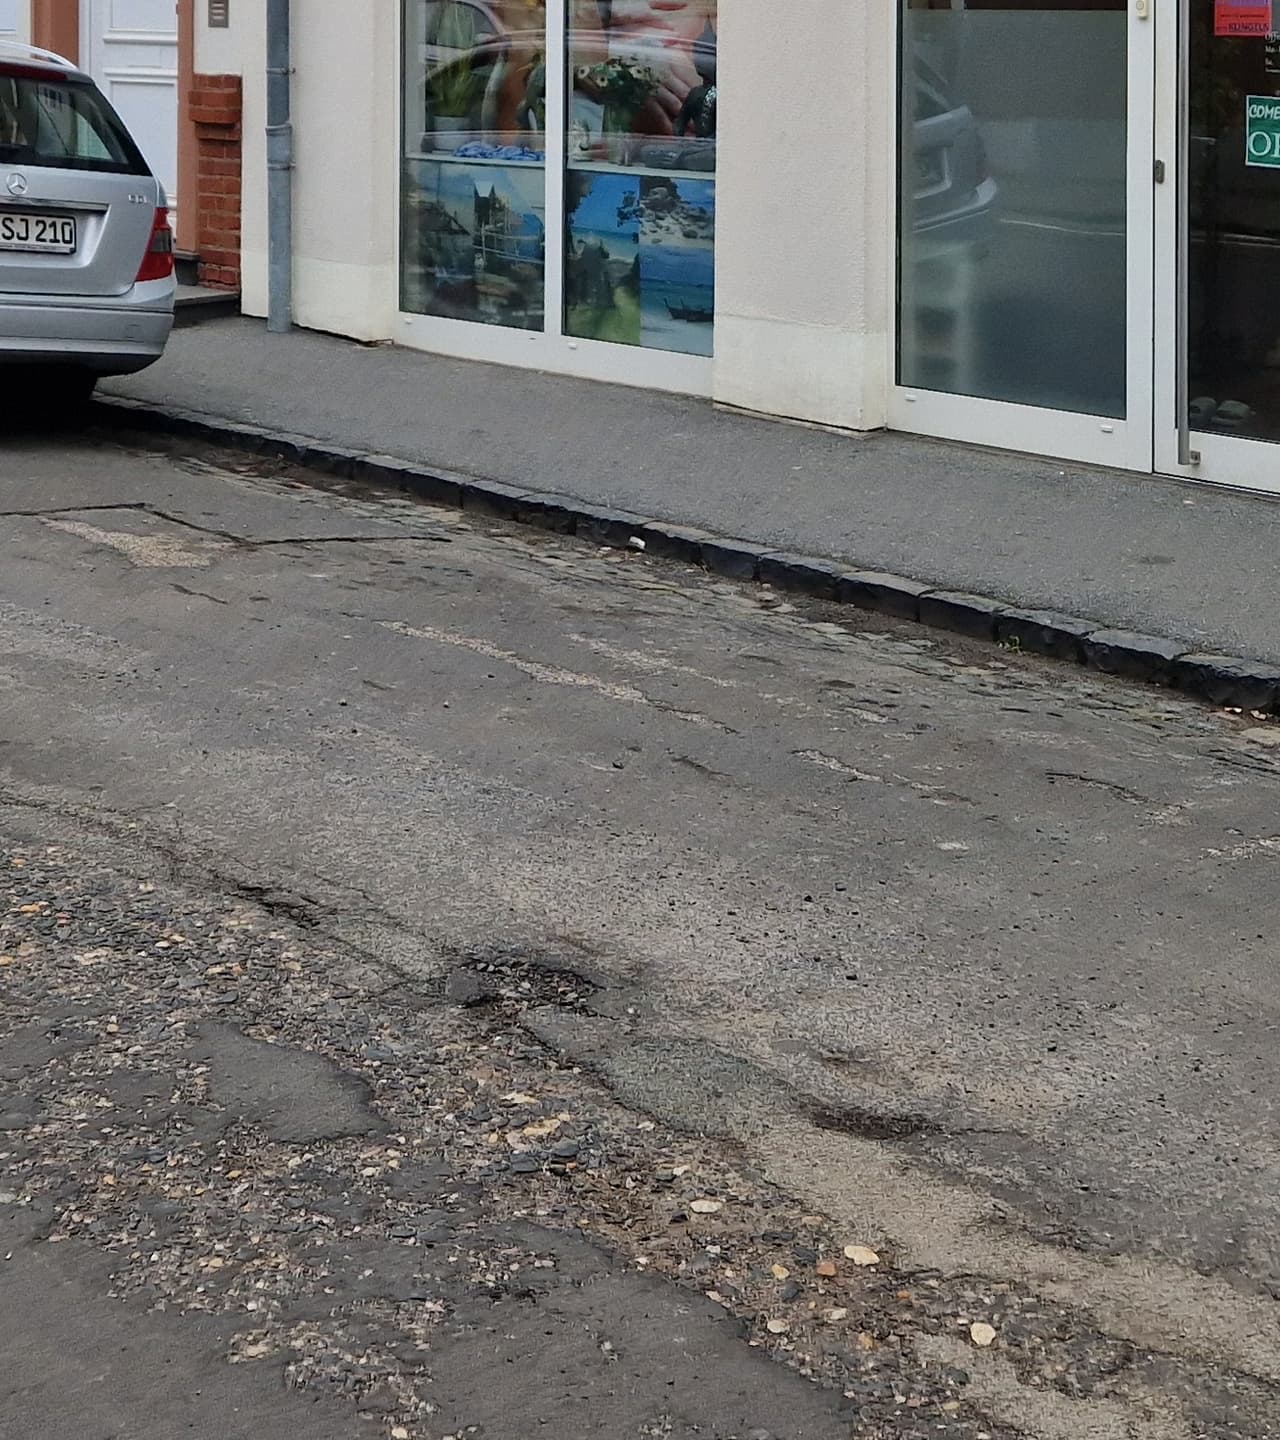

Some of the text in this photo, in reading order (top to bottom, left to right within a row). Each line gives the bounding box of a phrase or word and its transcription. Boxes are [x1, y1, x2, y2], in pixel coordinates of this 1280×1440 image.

[1248, 104, 1280, 120] COME
[1, 216, 30, 241] SJ
[34, 219, 74, 244] 210
